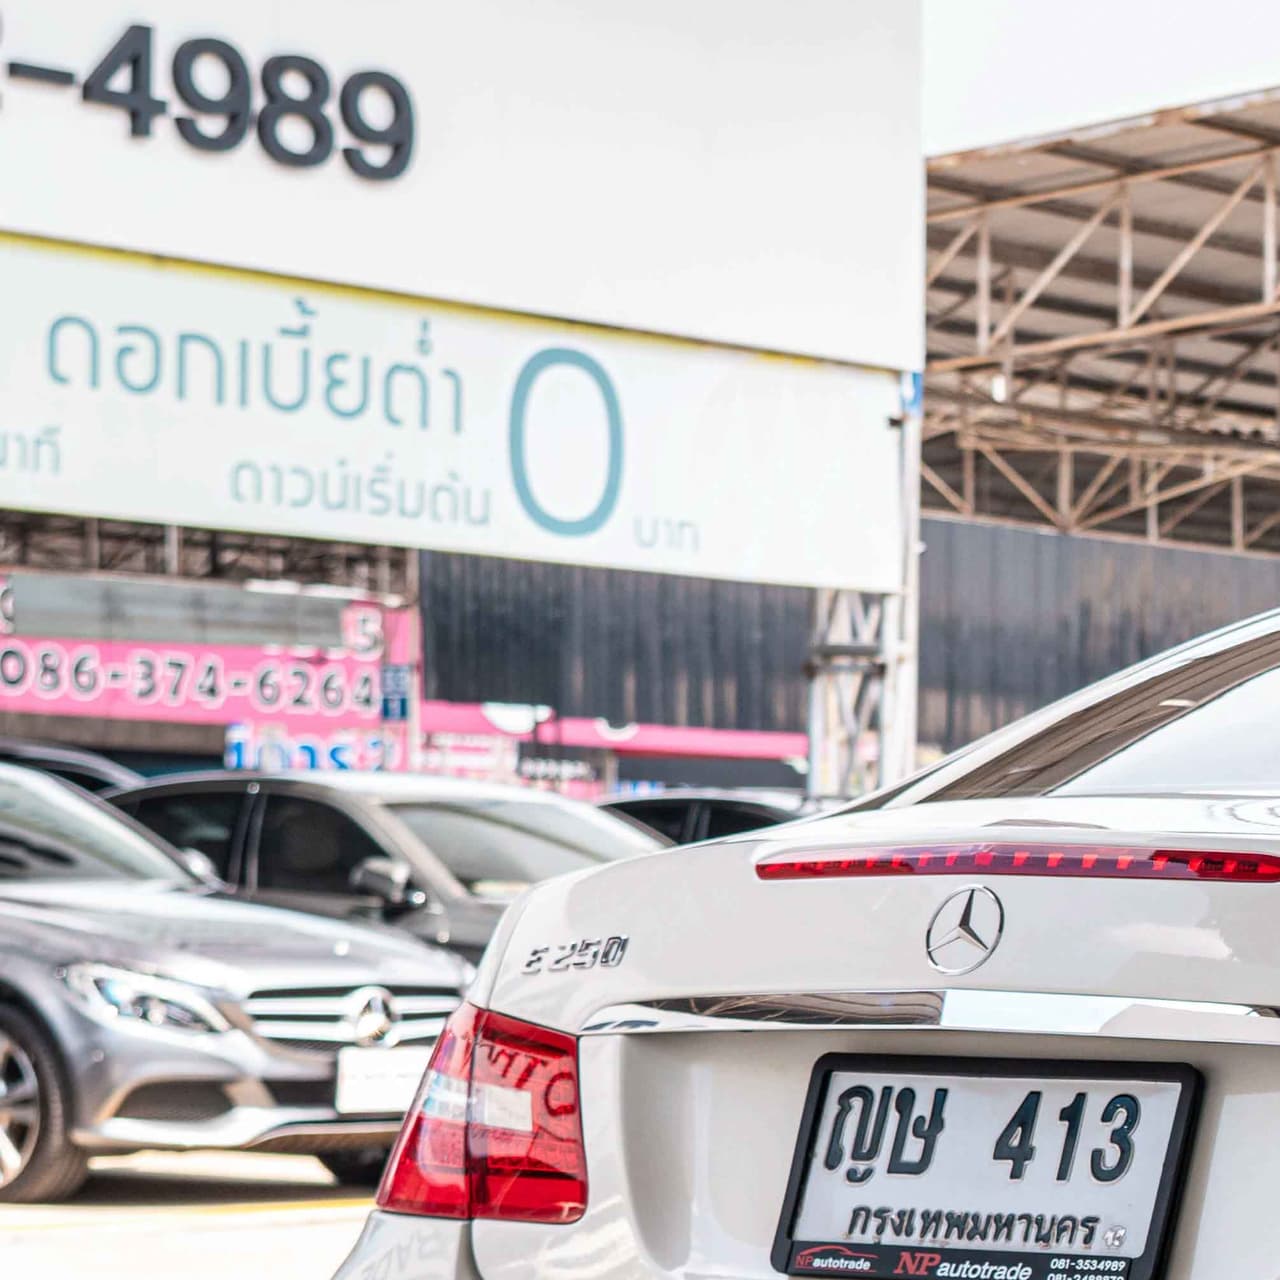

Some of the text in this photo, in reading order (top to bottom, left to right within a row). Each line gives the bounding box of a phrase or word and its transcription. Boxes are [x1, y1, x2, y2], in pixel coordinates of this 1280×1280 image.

[0, 11, 416, 182] -4989
[46, 297, 466, 435] ดอกเบี้ยต่ำ
[508, 346, 627, 538] 0
[0, 648, 377, 711] 086-374-6264
[548, 935, 630, 972] 250
[823, 1084, 1143, 1184] ญษ 413
[847, 1204, 1102, 1248] กรุงเทพมหานคร
[1049, 1258, 1126, 1272] 081-3534989
